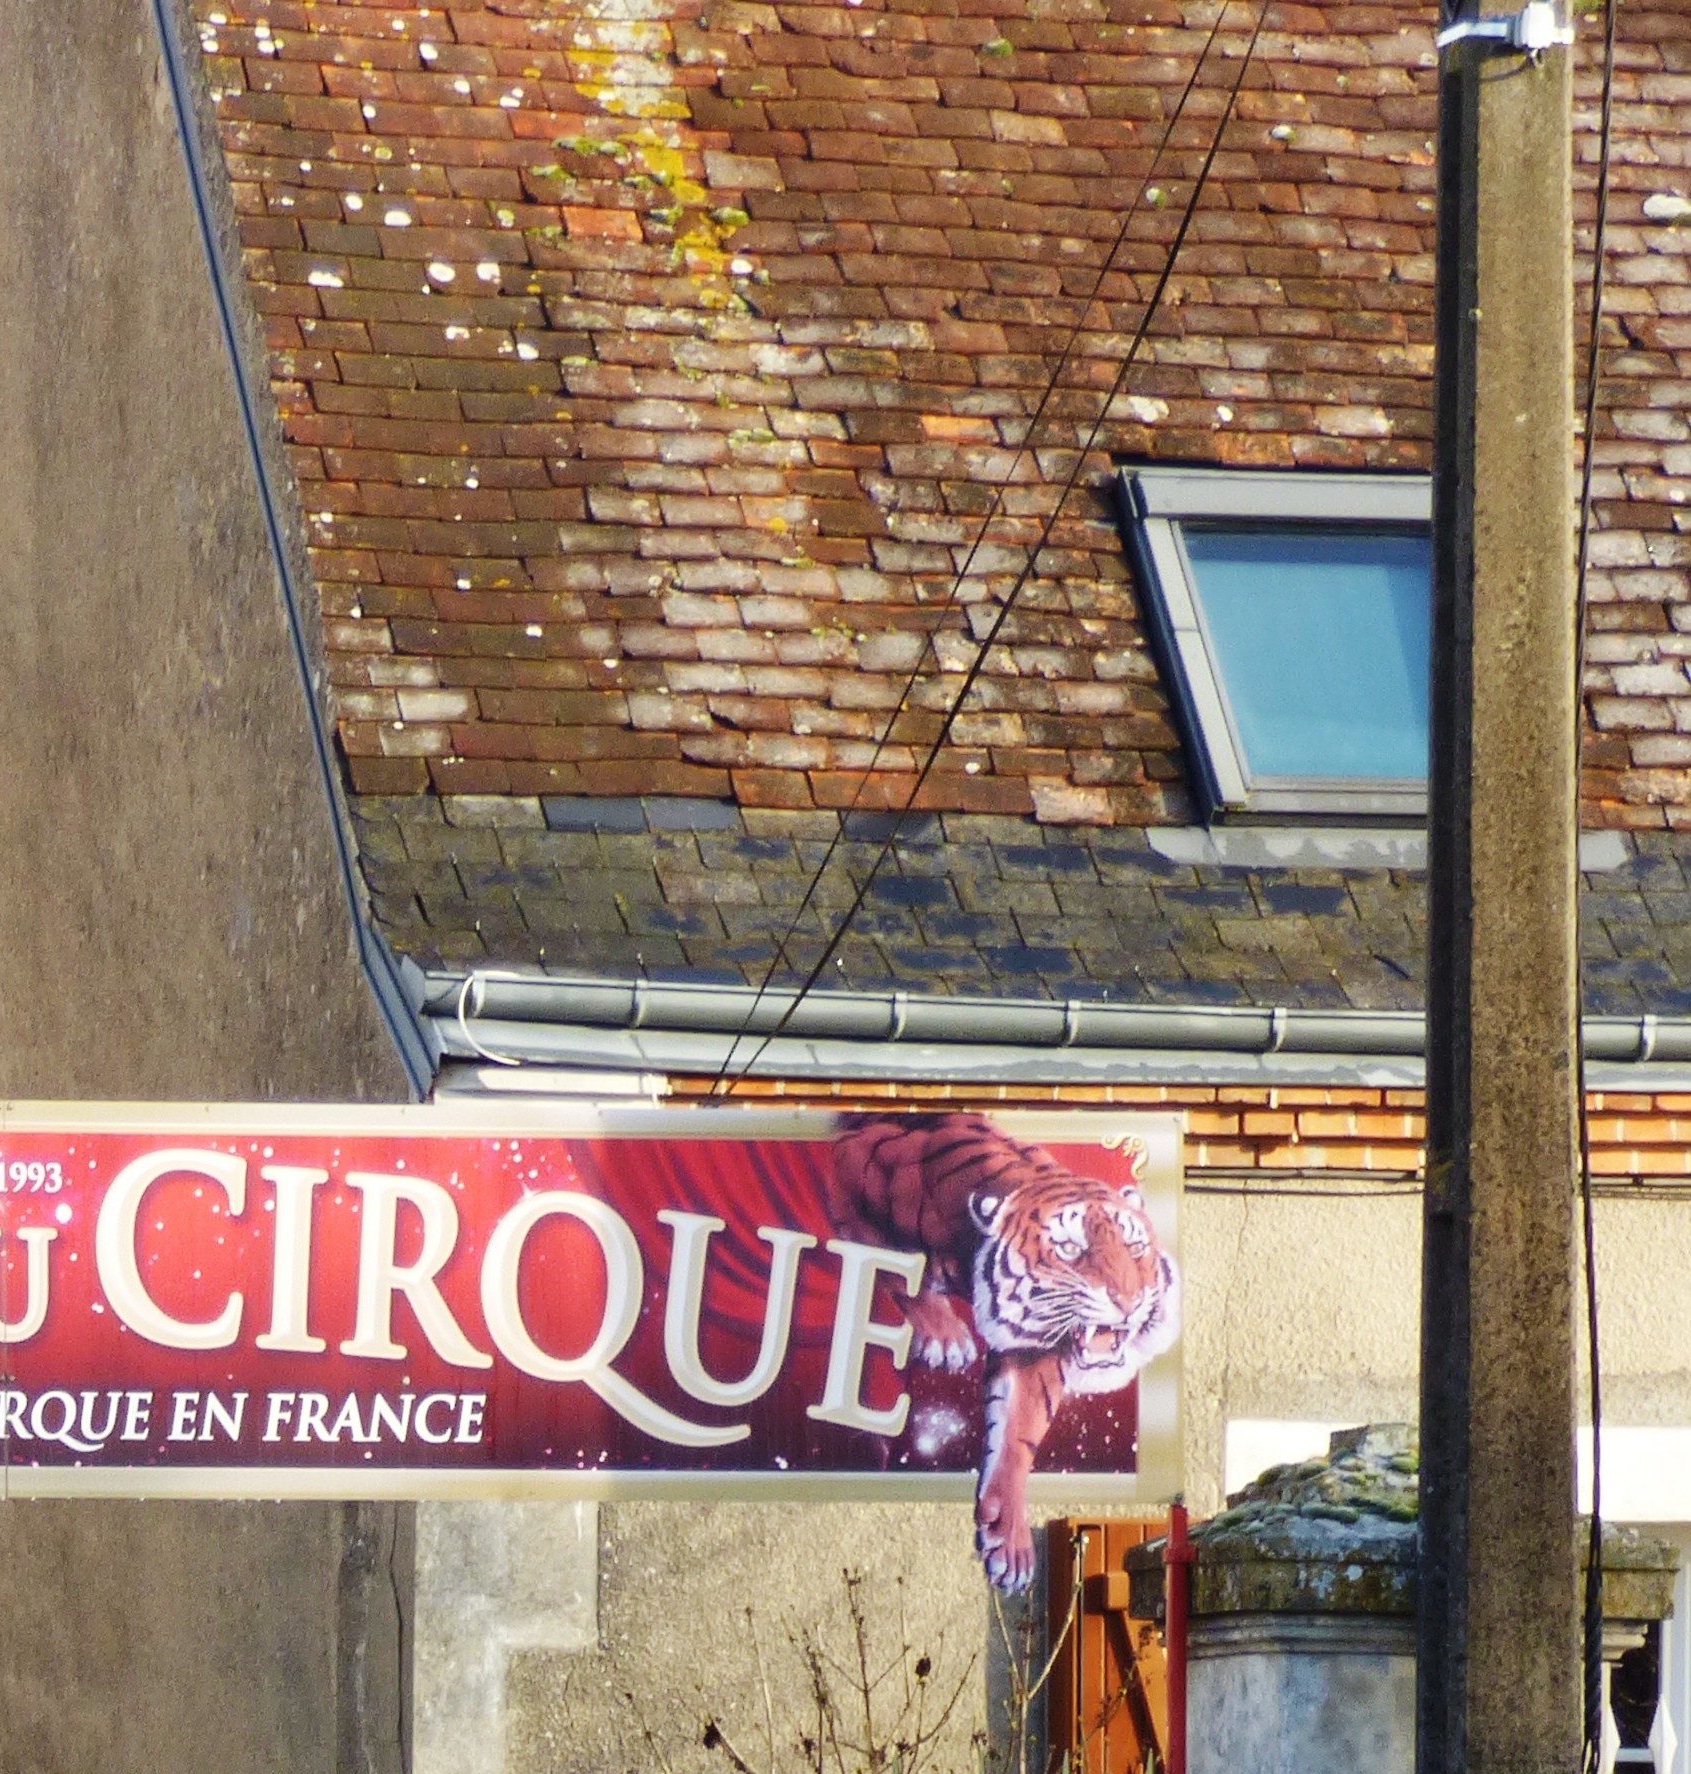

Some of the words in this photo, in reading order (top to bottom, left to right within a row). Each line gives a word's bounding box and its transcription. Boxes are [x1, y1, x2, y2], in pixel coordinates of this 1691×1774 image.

[95, 1148, 926, 1448] CIRQUE
[167, 1391, 249, 1441] EN
[263, 1391, 487, 1444] FRANCE
